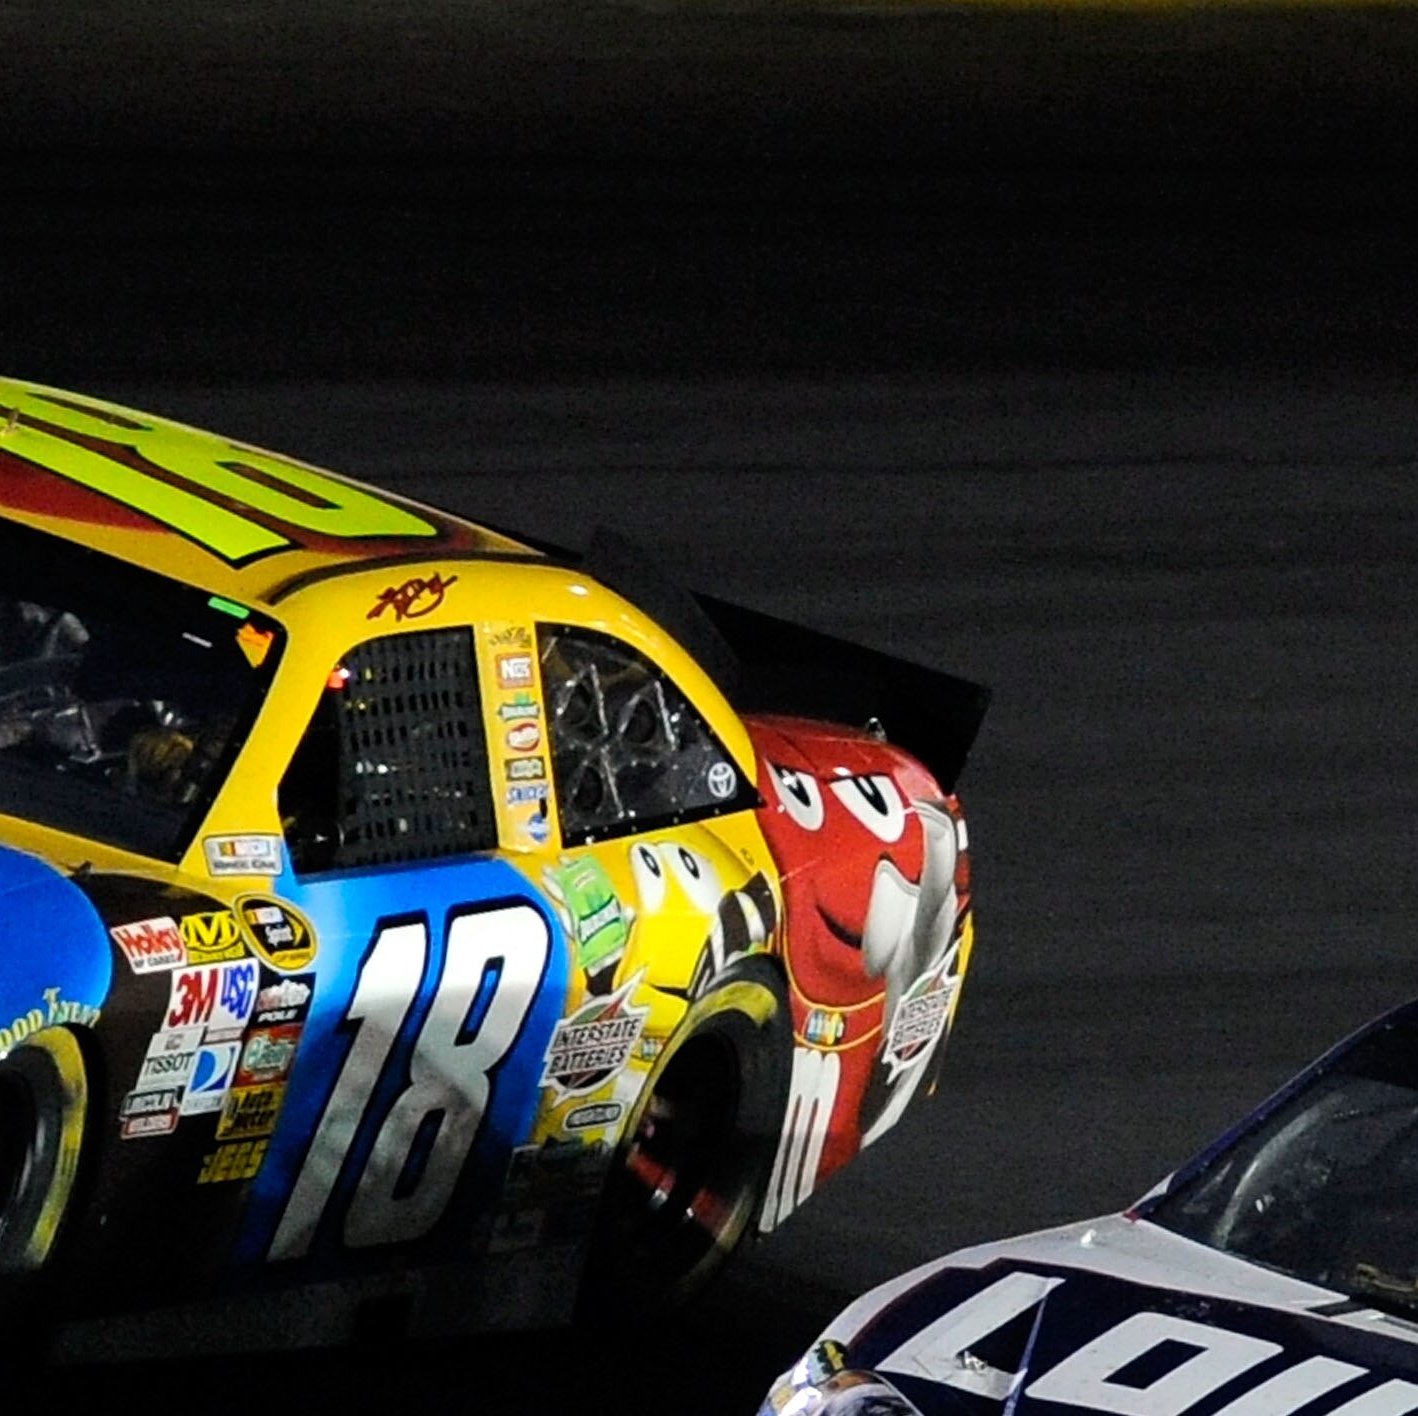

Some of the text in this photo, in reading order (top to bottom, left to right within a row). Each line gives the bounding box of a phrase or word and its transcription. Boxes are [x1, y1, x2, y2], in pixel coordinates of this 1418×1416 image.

[116, 923, 181, 962] Holley
[169, 967, 219, 1028] 3M
[220, 963, 254, 1020] USG
[256, 1008, 298, 1023] POLE
[552, 1015, 641, 1047] INTERSTATE
[143, 1051, 196, 1076] TISSOT
[548, 1043, 629, 1075] BATTERIES
[267, 905, 549, 1263] 18
